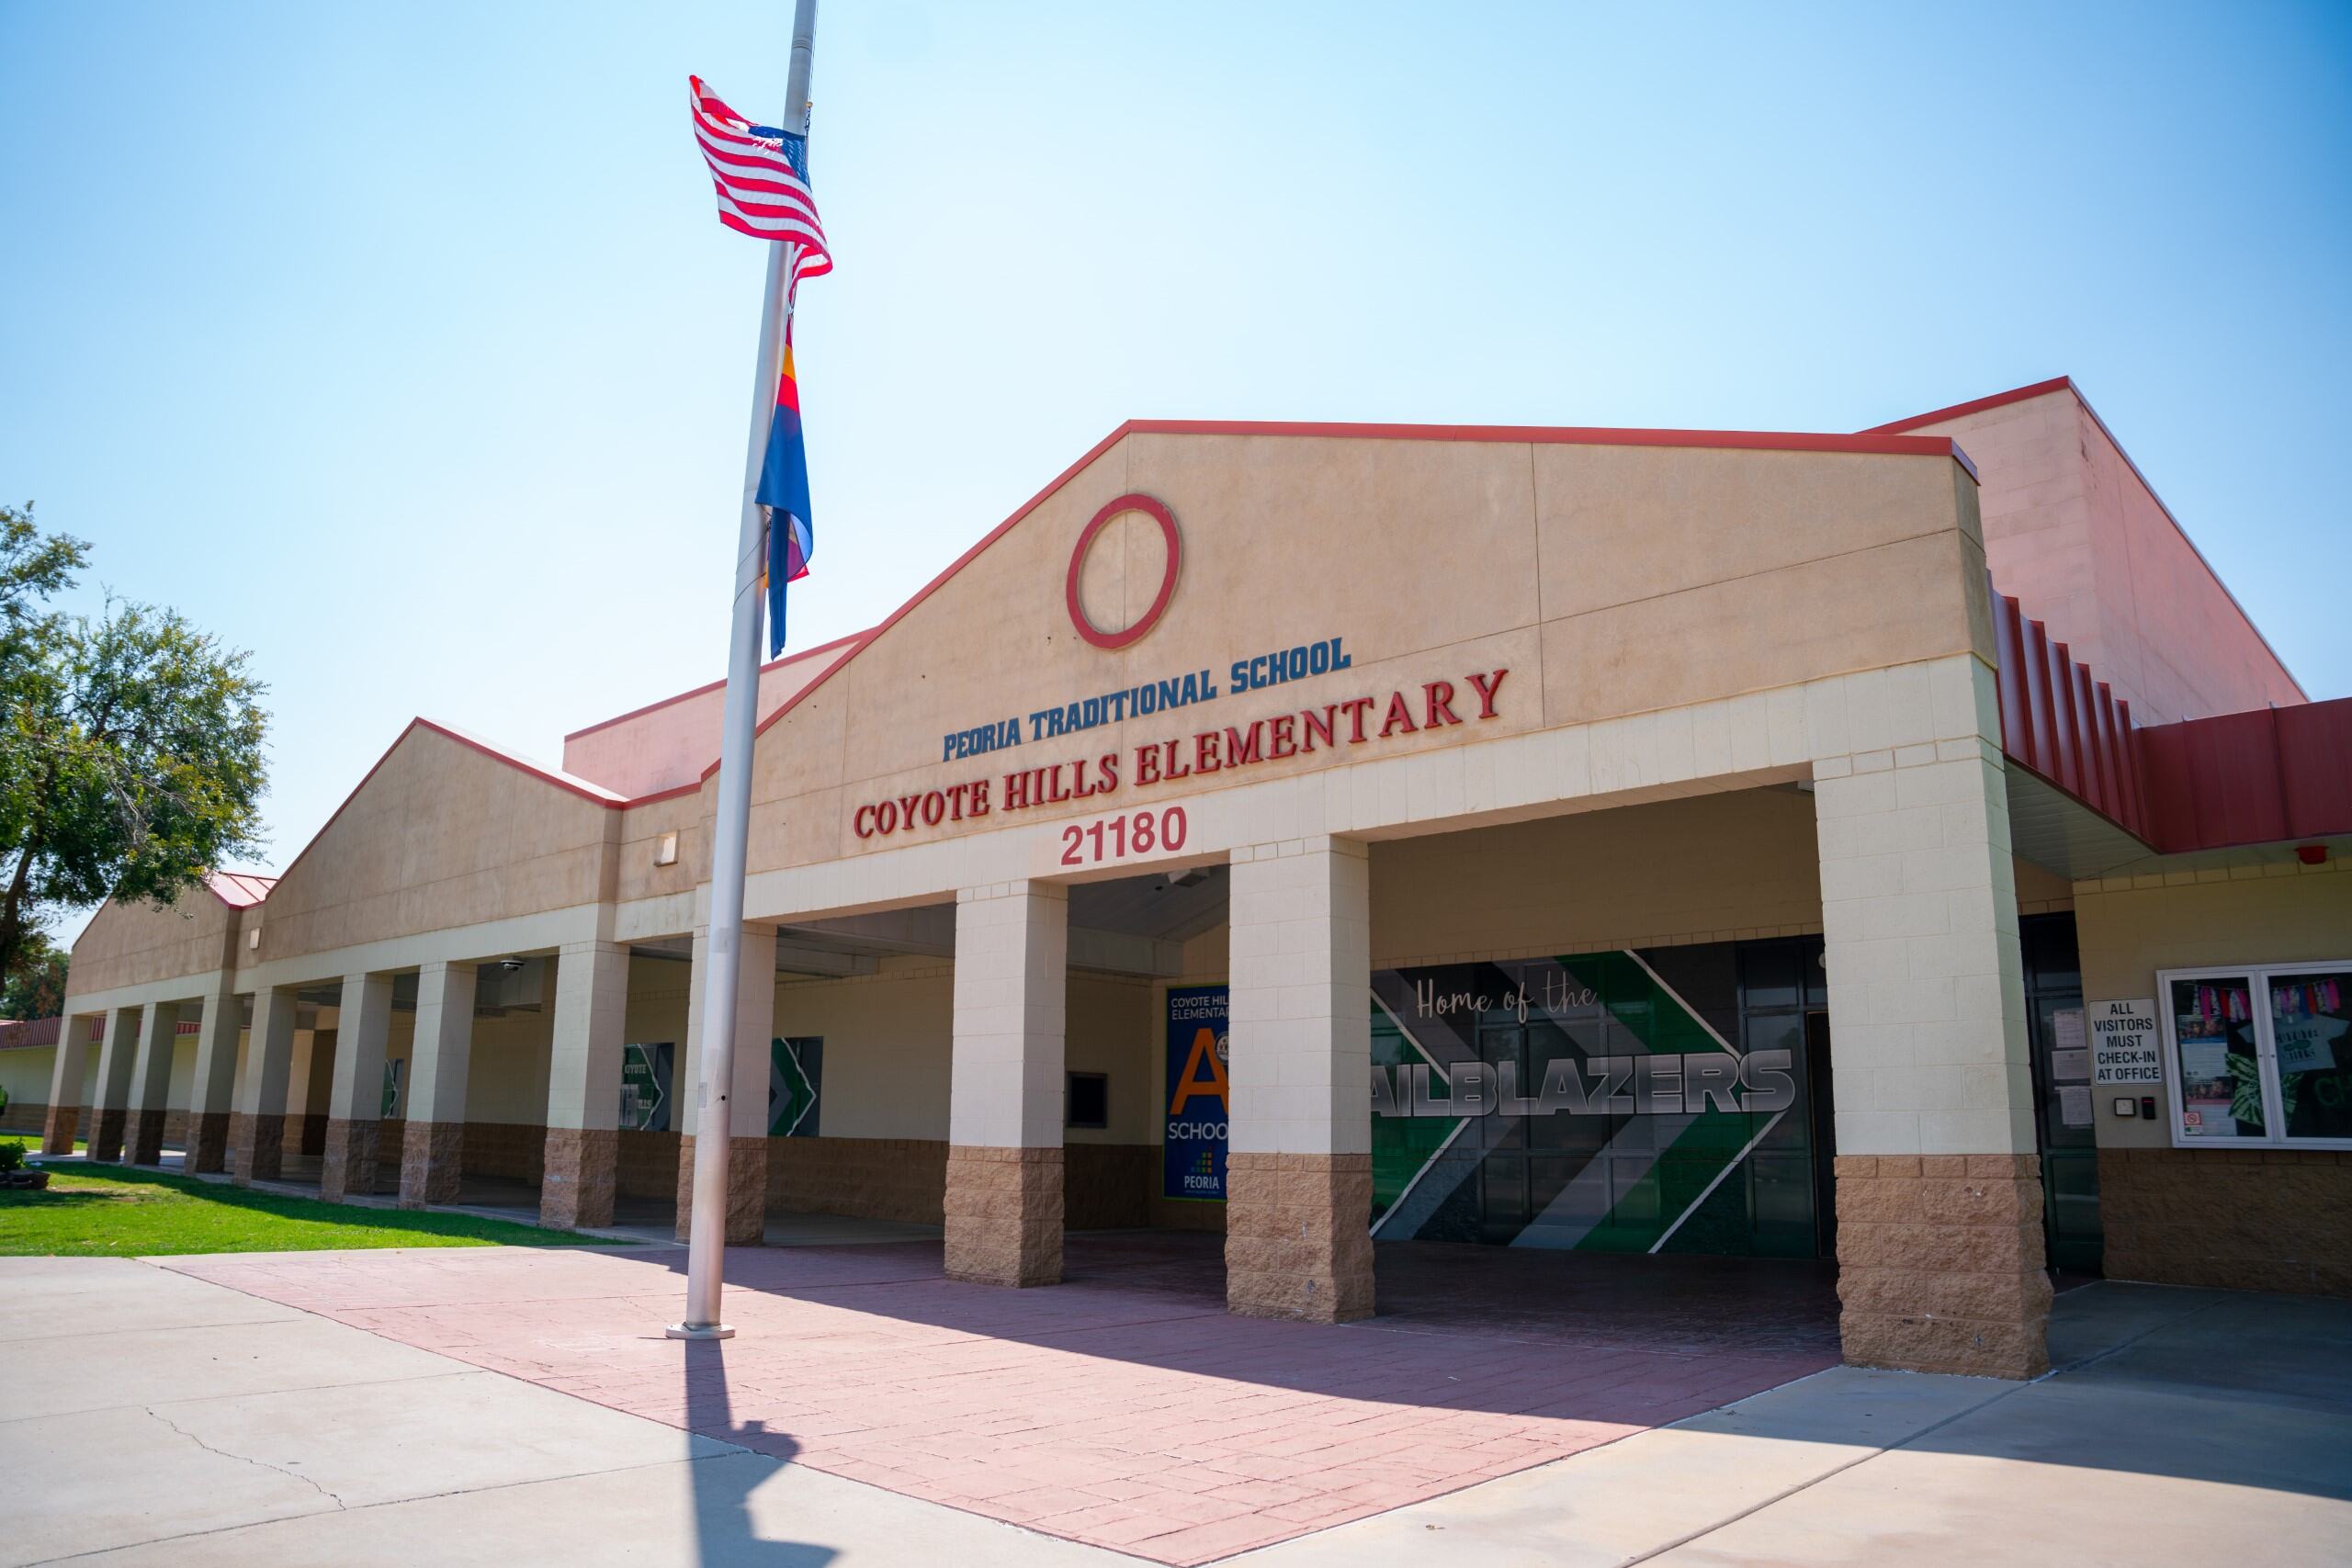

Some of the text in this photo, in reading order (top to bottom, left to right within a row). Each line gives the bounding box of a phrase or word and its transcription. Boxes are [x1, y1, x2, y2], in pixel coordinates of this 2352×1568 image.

[943, 637, 1351, 762] PEORIA TRADITIONAL SCHOOL
[854, 669, 1509, 839] COYOTE HILLS ELEMENTARY
[1061, 807, 1187, 865] 21180
[1171, 995, 1228, 1008] COYOTE HIL
[1417, 970, 1598, 1023] Home of the
[1171, 1007, 1229, 1020] ELEMENTA
[2110, 1002, 2133, 1015] ALL
[2094, 1018, 2153, 1032] VISITORS
[2107, 1034, 2143, 1048] MUST
[2098, 1051, 2156, 1065] CHECK-IN
[1170, 1028, 1228, 1115] A
[2098, 1066, 2160, 1080] AT OFFICE
[1370, 1049, 1796, 1117] AILBLAZERS
[1168, 1122, 1228, 1140] SCHOO
[1184, 1175, 1220, 1189] PEORIA
